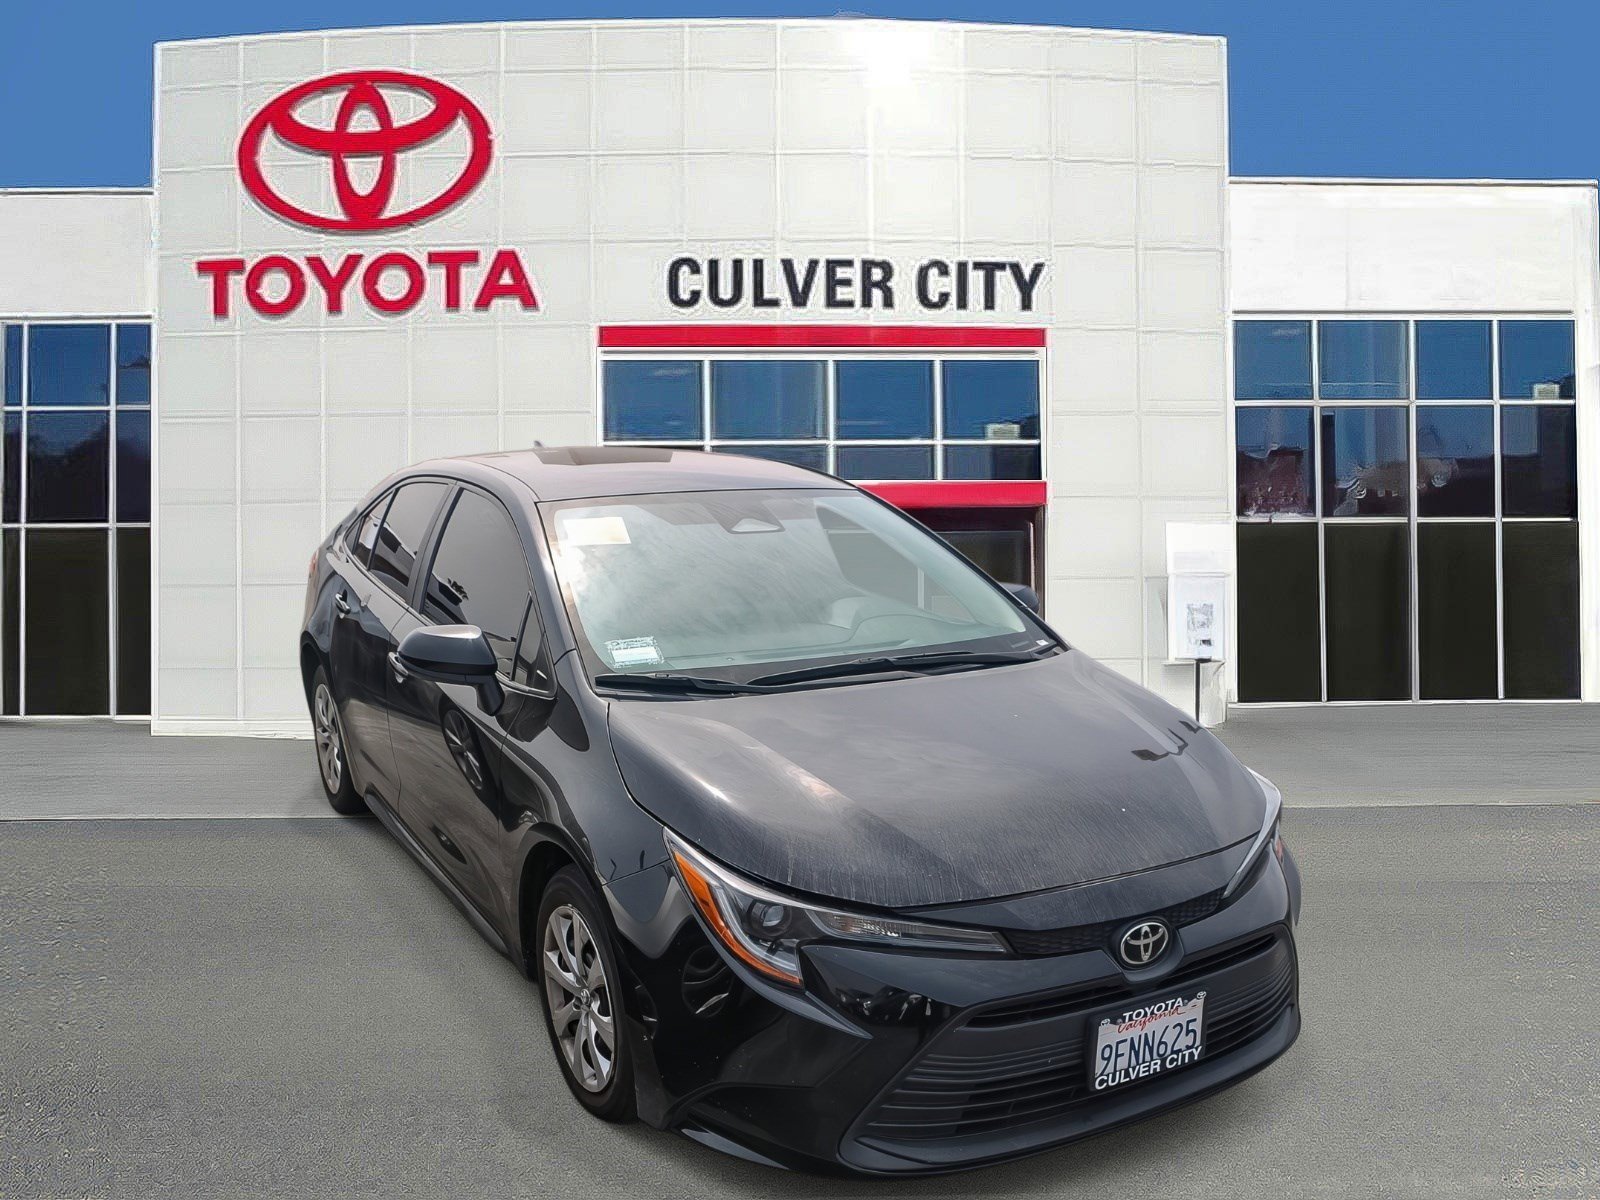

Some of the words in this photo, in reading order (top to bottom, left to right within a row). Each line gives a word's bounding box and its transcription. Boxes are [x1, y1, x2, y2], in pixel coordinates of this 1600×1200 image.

[196, 249, 540, 319] TOYOTA
[667, 257, 895, 310] CULVER
[917, 259, 1046, 312] CITY
[1122, 997, 1184, 1023] TOYOTA
[1095, 1059, 1161, 1090] CULVER
[1166, 1046, 1203, 1069] CITY
[1096, 1018, 1198, 1076] 9FNN625
